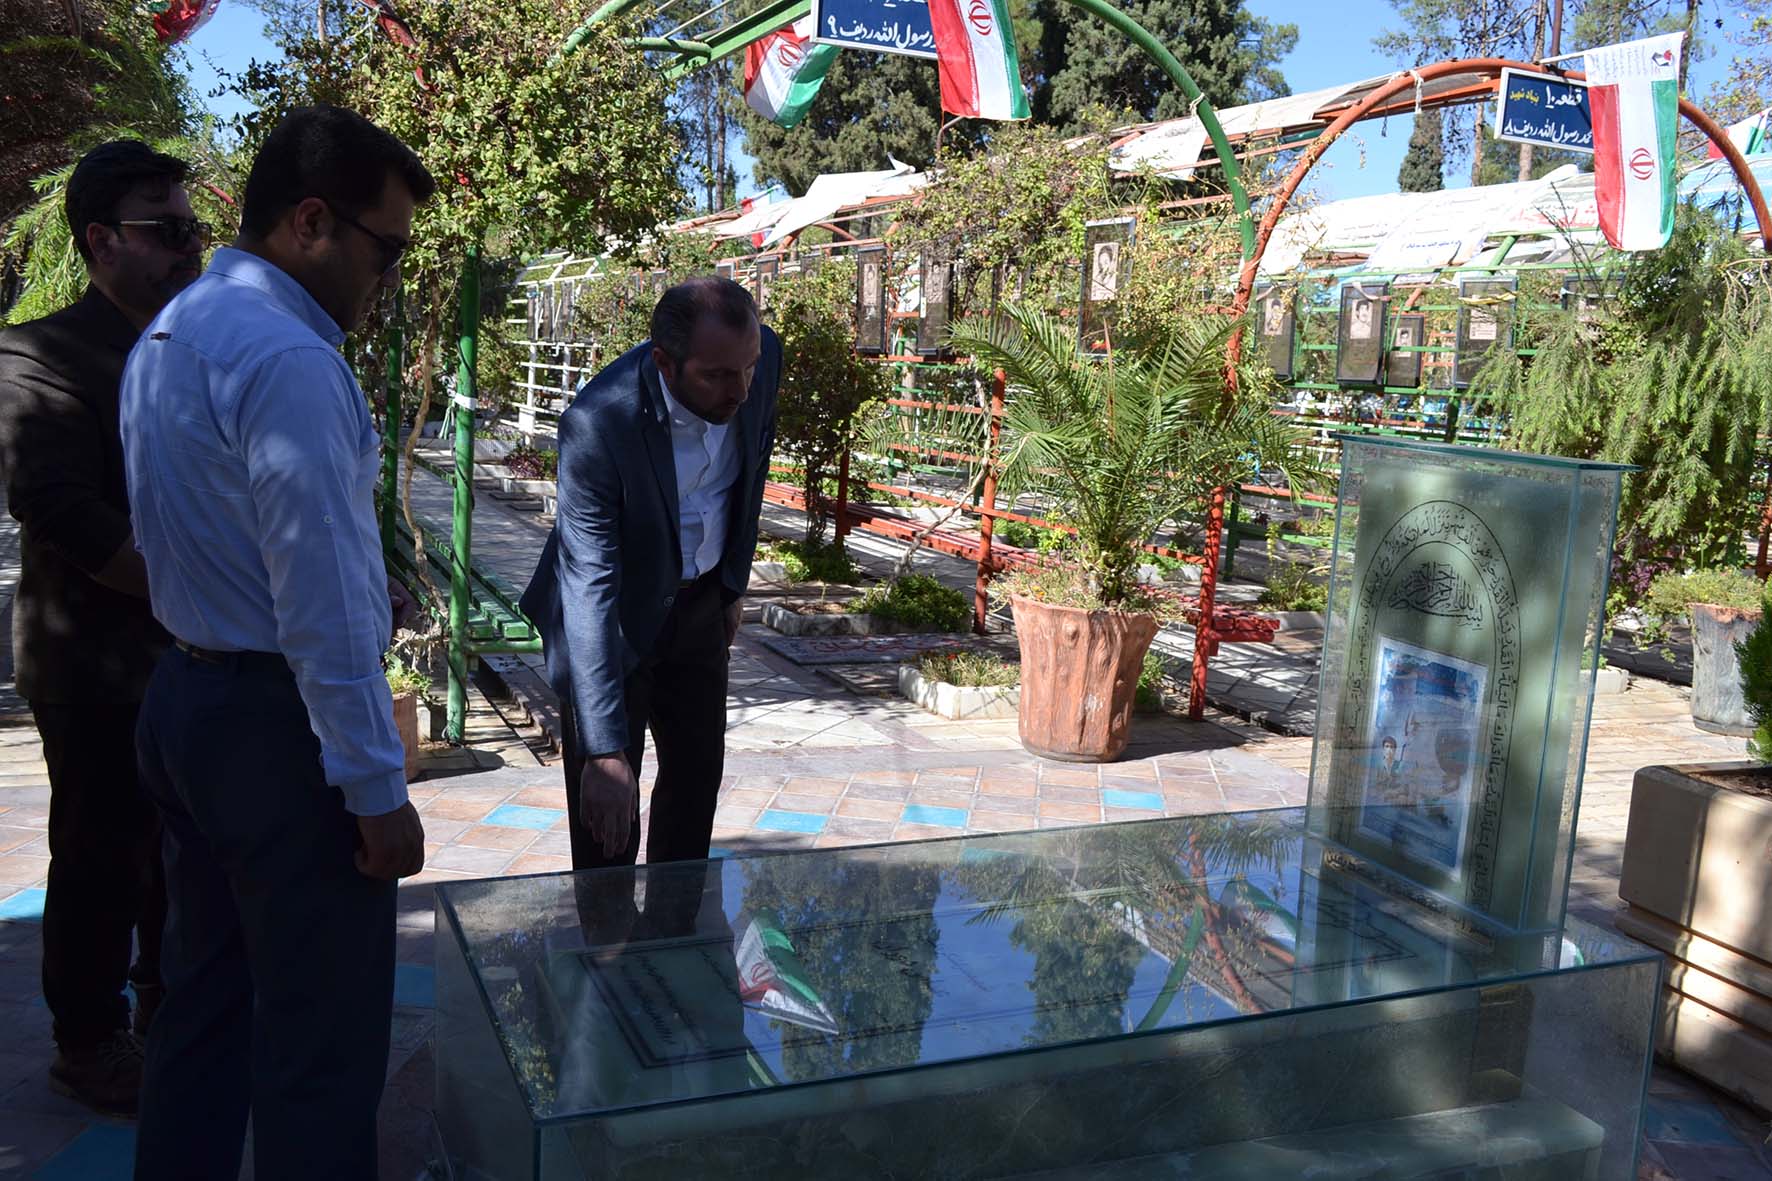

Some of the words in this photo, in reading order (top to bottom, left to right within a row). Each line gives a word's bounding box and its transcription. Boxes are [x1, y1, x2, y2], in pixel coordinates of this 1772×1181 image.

[840, 20, 874, 41] ردیف
[873, 20, 898, 42] الله
[895, 23, 933, 49] رسول
[1555, 86, 1583, 106] قطعه
[1513, 120, 1538, 137] ردیف
[1538, 118, 1555, 138] الله
[1552, 124, 1579, 143] رسول
